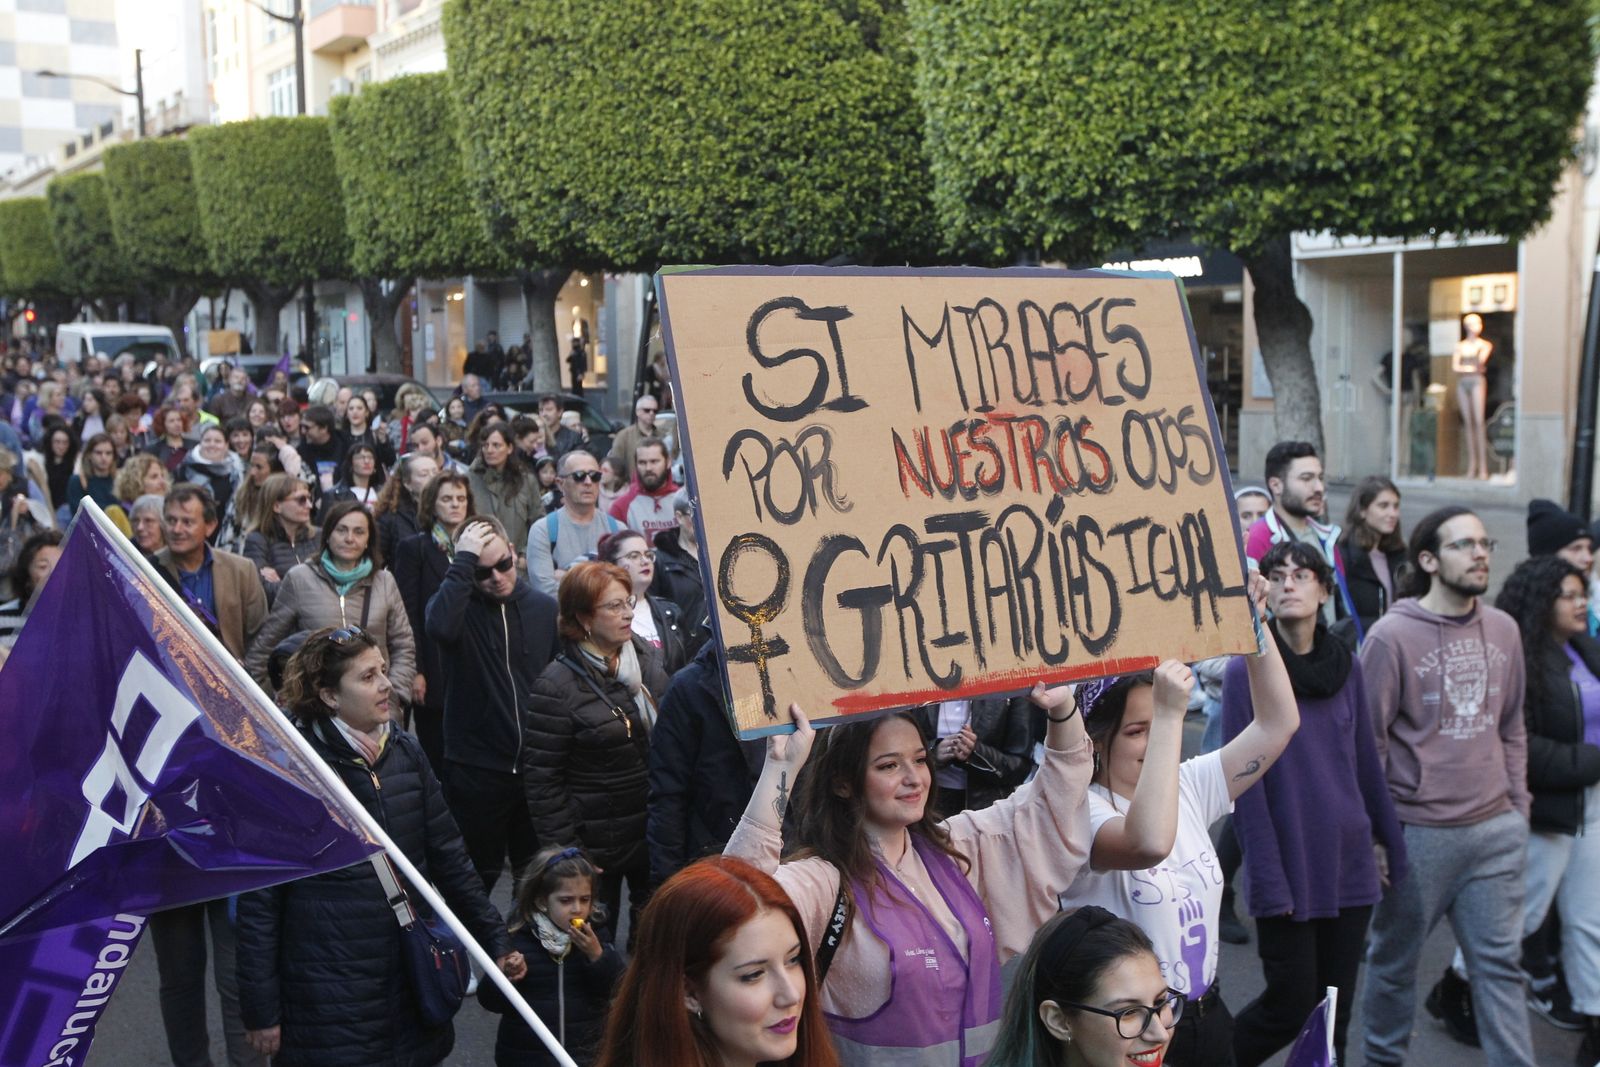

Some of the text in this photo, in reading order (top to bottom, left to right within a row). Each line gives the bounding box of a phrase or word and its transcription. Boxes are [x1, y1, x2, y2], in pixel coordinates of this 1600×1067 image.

[741, 295, 1152, 422] SI MIRASES
[722, 405, 1216, 525] POR NUESTROS OJOS
[1106, 508, 1248, 632] IGUAL
[43, 912, 146, 1067] ndalucí
